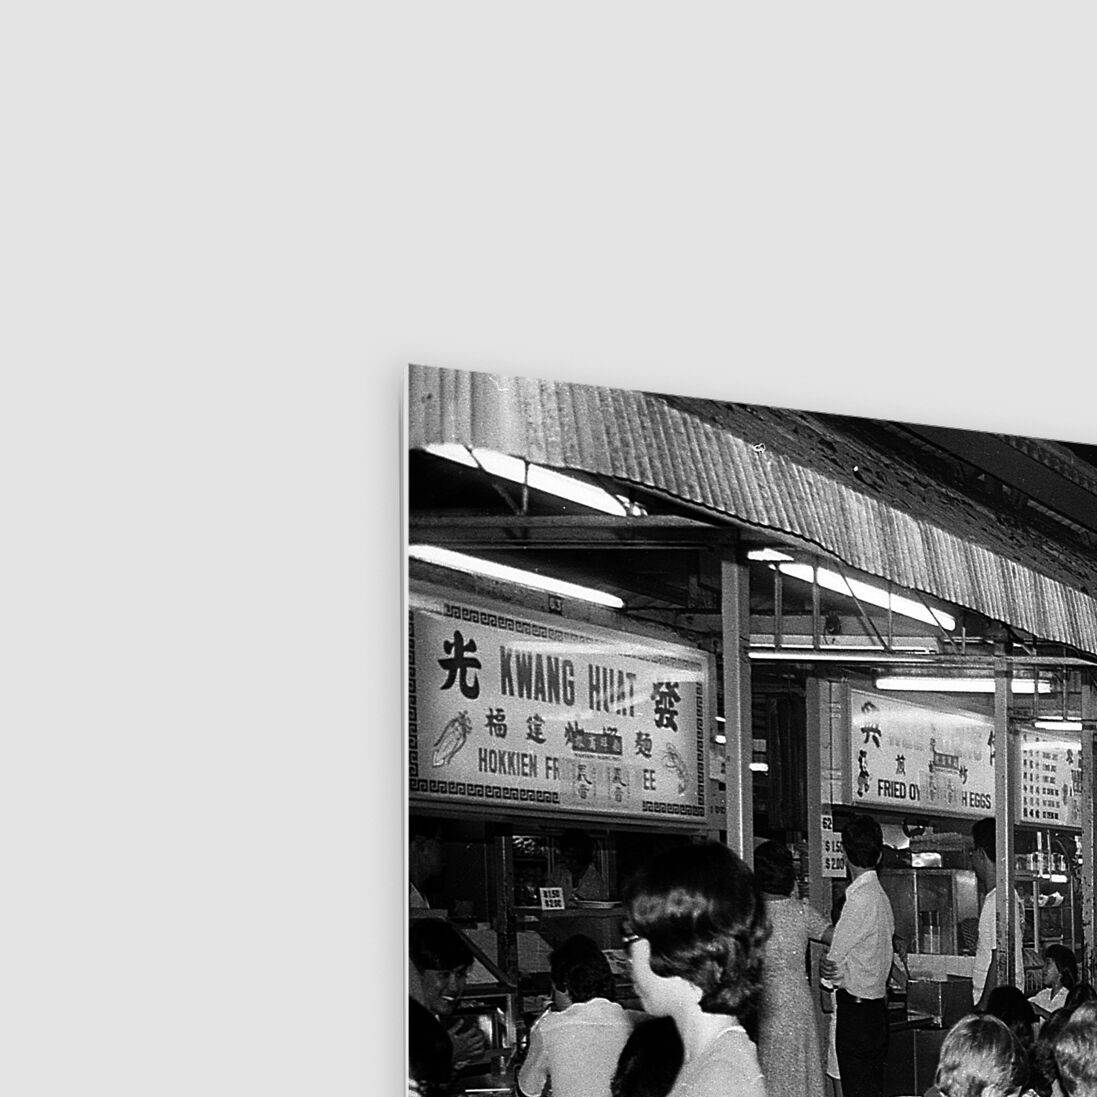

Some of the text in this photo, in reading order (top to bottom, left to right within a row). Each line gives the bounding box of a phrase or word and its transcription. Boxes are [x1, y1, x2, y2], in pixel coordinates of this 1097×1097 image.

[438, 630, 482, 700] 光
[500, 647, 637, 718] KWANG HUAT
[478, 747, 538, 779] HOKKIEN
[878, 778, 907, 800] FRIED
[969, 791, 992, 810] EGGS
